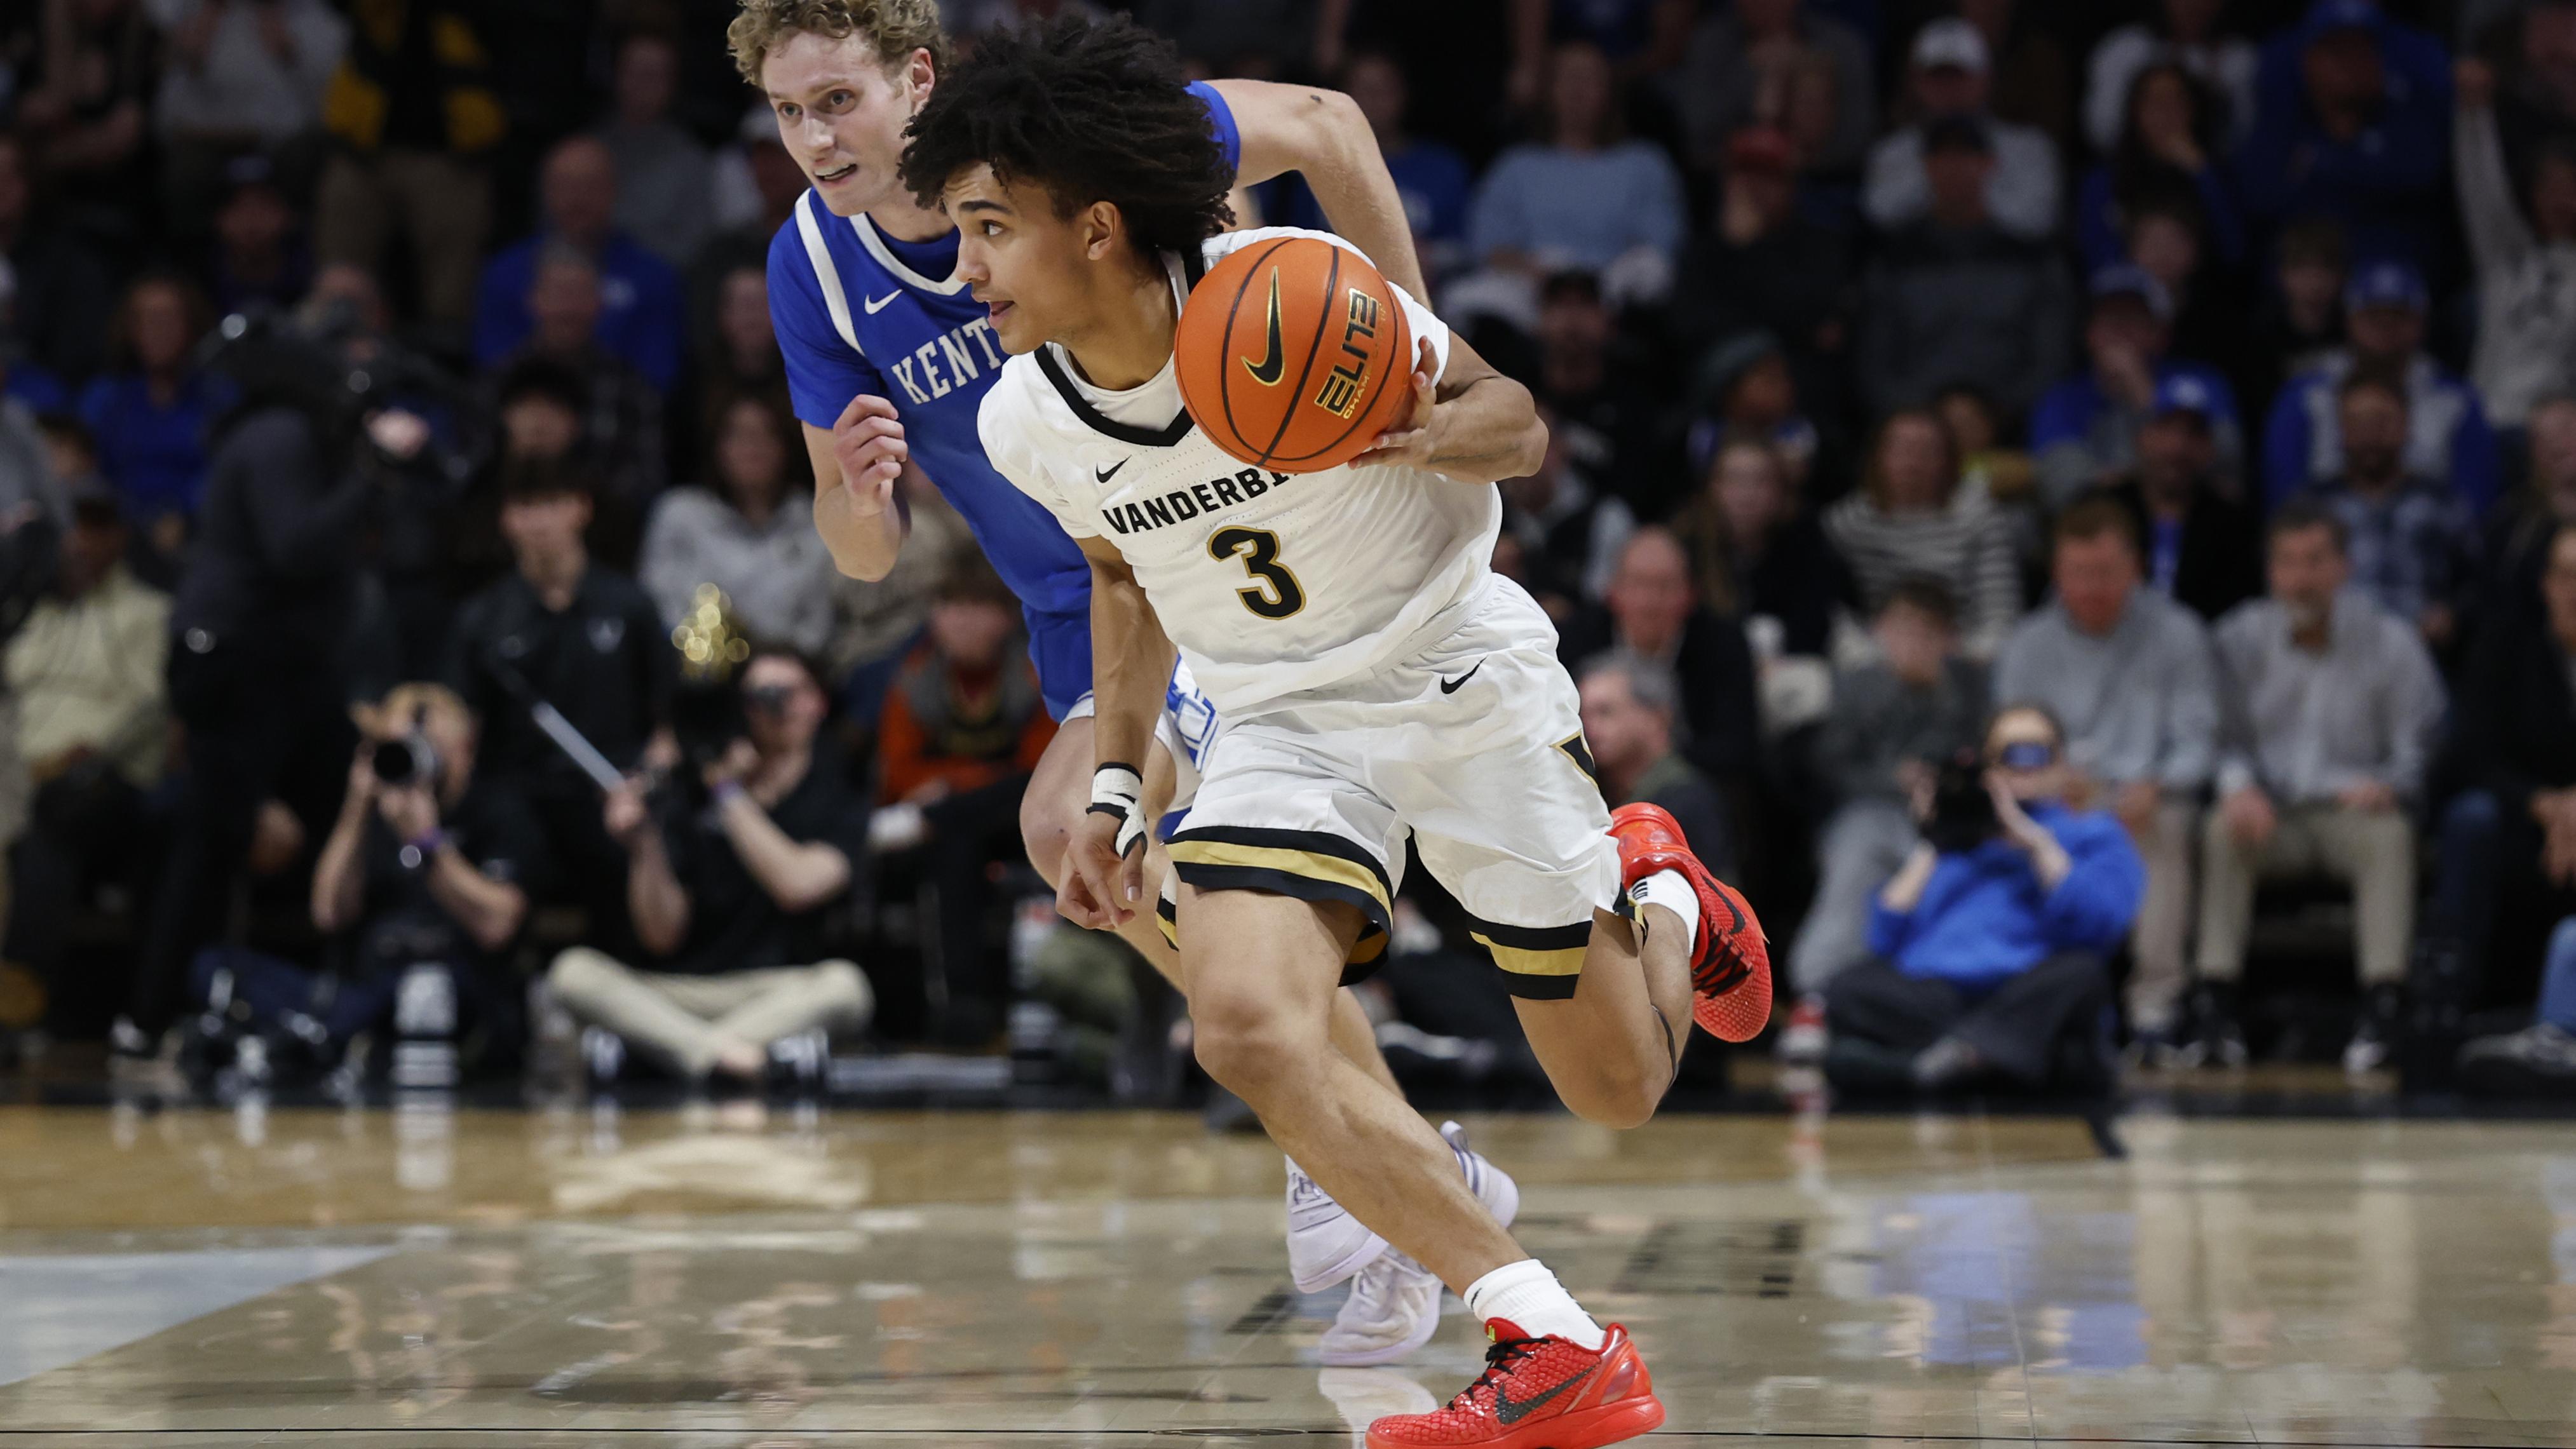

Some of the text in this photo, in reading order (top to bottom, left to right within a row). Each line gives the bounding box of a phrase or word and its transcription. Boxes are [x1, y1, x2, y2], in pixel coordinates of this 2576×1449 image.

[891, 316, 1002, 405] KENT
[1315, 288, 1378, 416] ELITE
[1101, 468, 1290, 534] VANDERBI
[1207, 525, 1306, 620] 3
